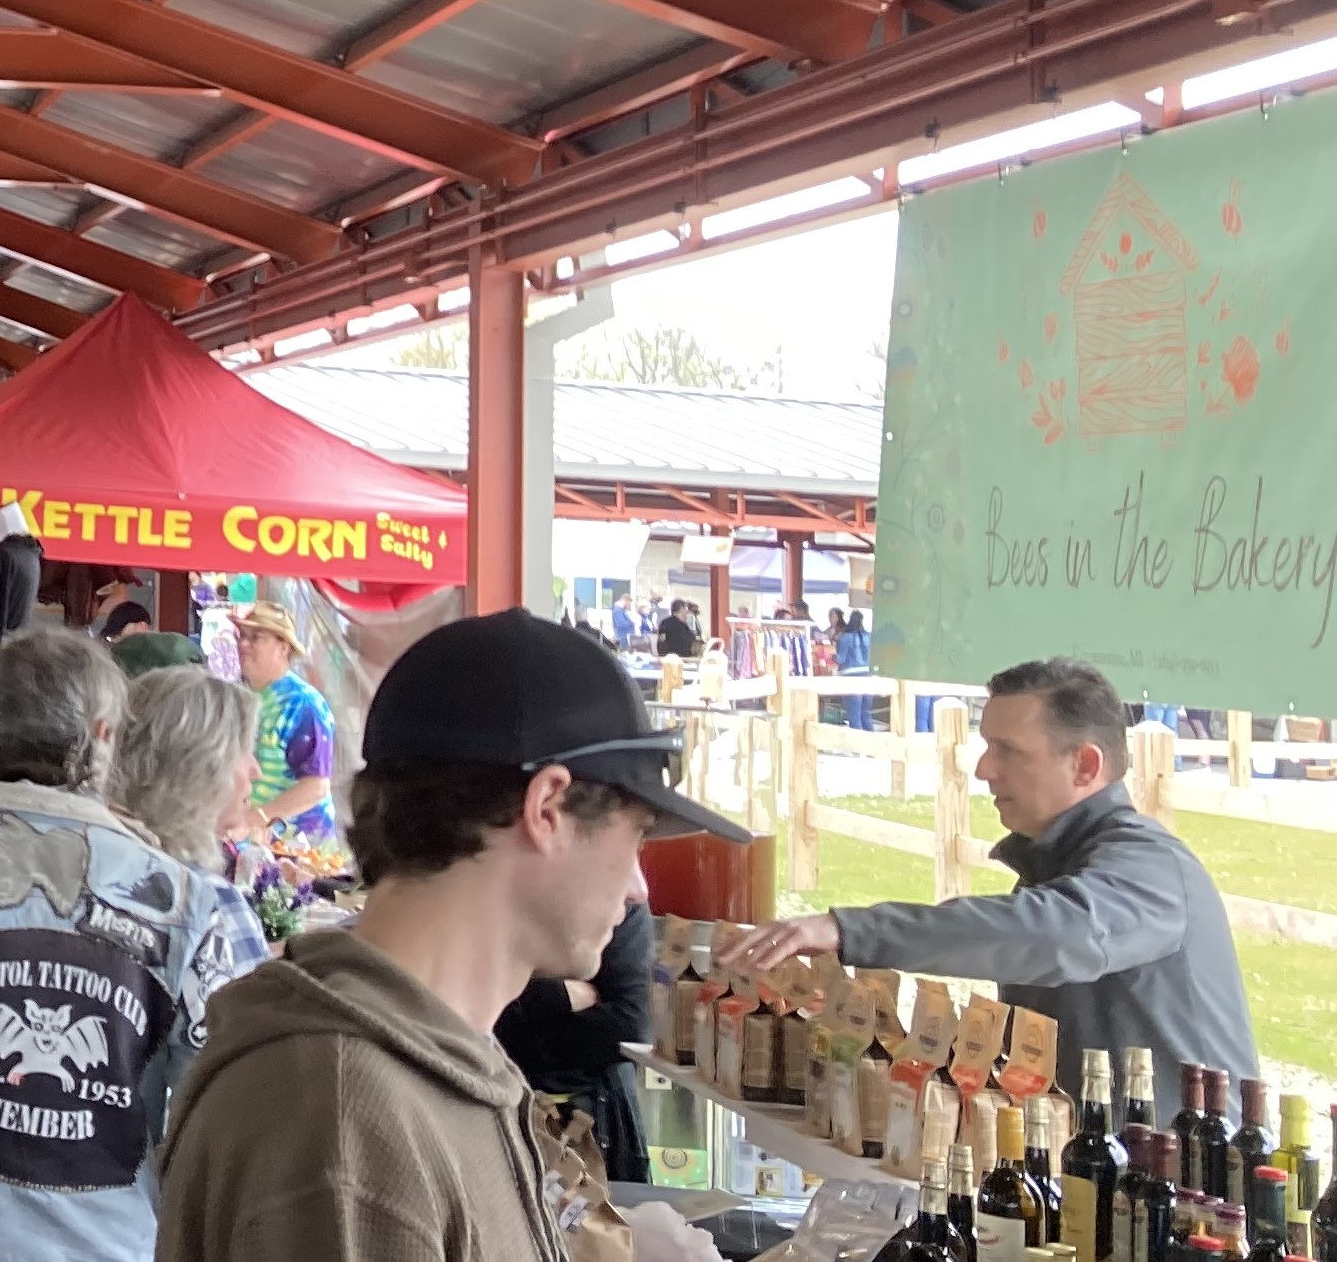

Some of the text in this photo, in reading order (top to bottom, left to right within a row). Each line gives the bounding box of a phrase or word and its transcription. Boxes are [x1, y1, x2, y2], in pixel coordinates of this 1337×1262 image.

[1, 488, 368, 562] KETTLE CORN
[376, 511, 431, 544] Sweet
[380, 534, 433, 570] Salty
[984, 470, 1337, 649] Bees in the Bakery
[38, 961, 112, 1005] TATTOO
[78, 1078, 133, 1109] 1953
